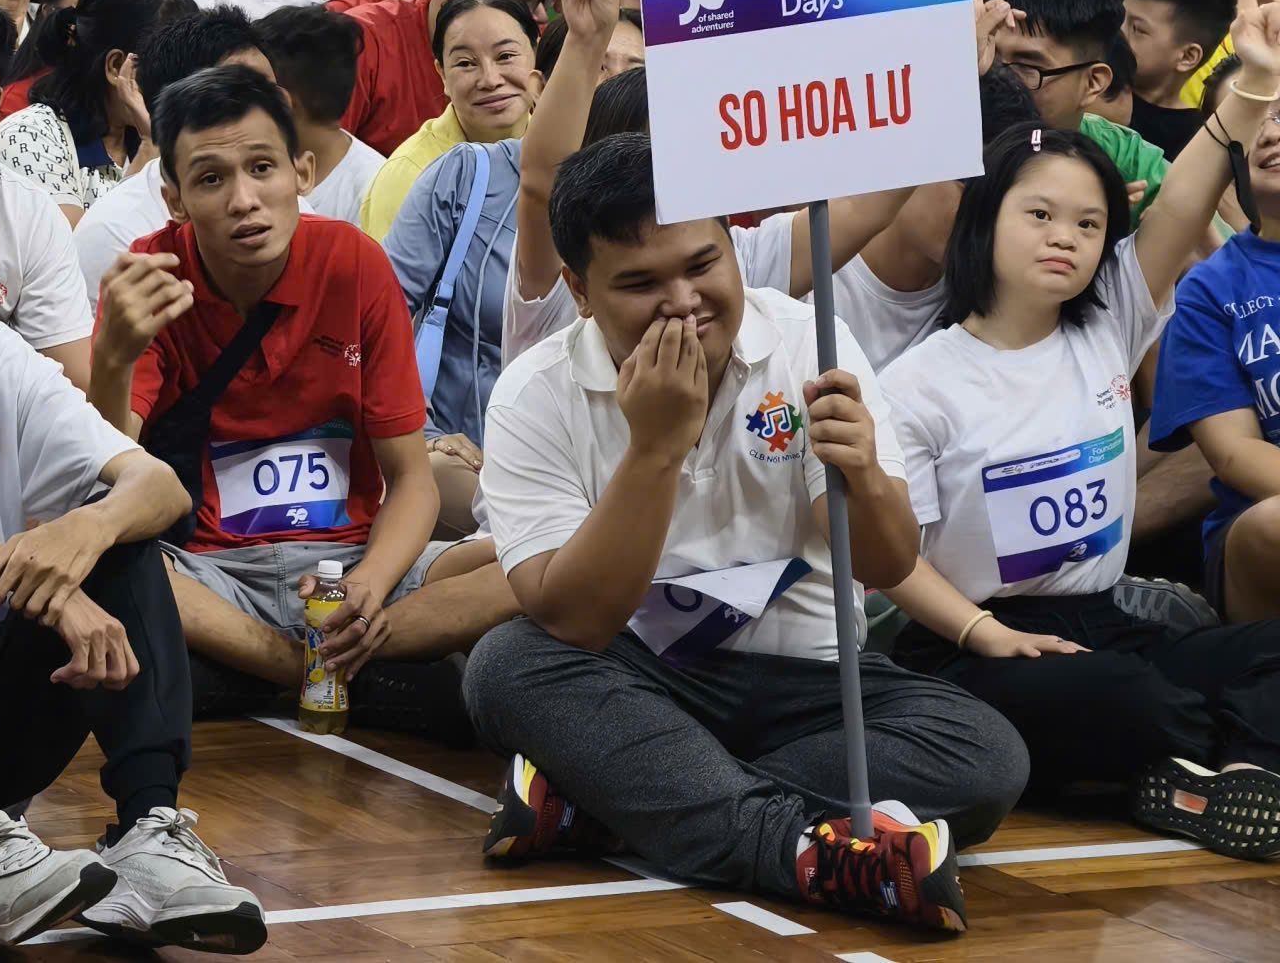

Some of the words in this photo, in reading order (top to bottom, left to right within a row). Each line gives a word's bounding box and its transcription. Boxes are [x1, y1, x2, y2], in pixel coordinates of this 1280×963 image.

[691, 21, 735, 34] adventures
[698, 12, 708, 23] of
[708, 10, 735, 22] shared
[718, 89, 768, 151] SO
[778, 76, 858, 142] HOA
[865, 64, 912, 129] LƯ
[750, 449, 765, 460] CLB
[253, 452, 329, 496] 075
[1029, 478, 1108, 537] 083
